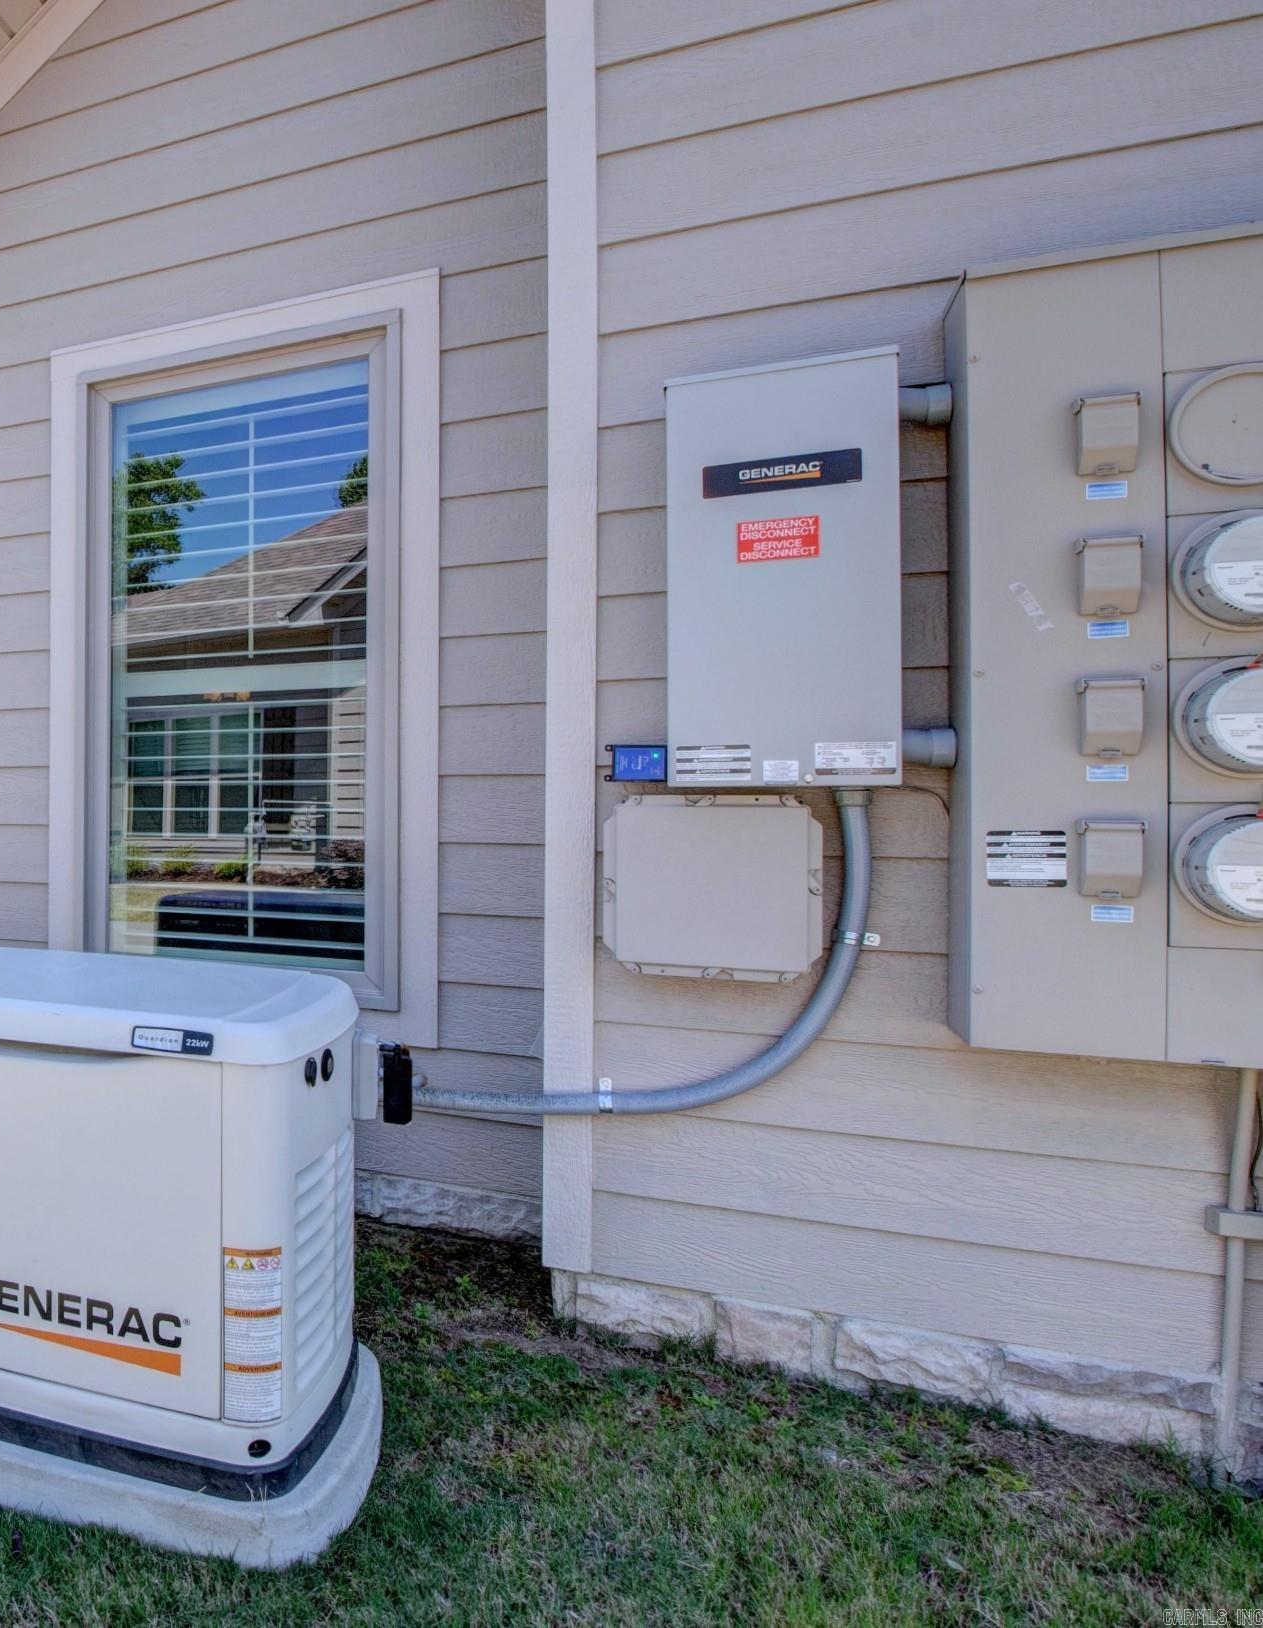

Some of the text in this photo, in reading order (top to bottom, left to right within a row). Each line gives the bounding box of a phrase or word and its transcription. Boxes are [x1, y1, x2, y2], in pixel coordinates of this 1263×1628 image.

[738, 461, 821, 480] GENERAC
[741, 517, 816, 532] EMERGENCY
[740, 526, 816, 541] DISCONNECT
[753, 538, 803, 551] SERVICE
[740, 546, 816, 561] DISCONNECT
[185, 1038, 210, 1048] 22kW
